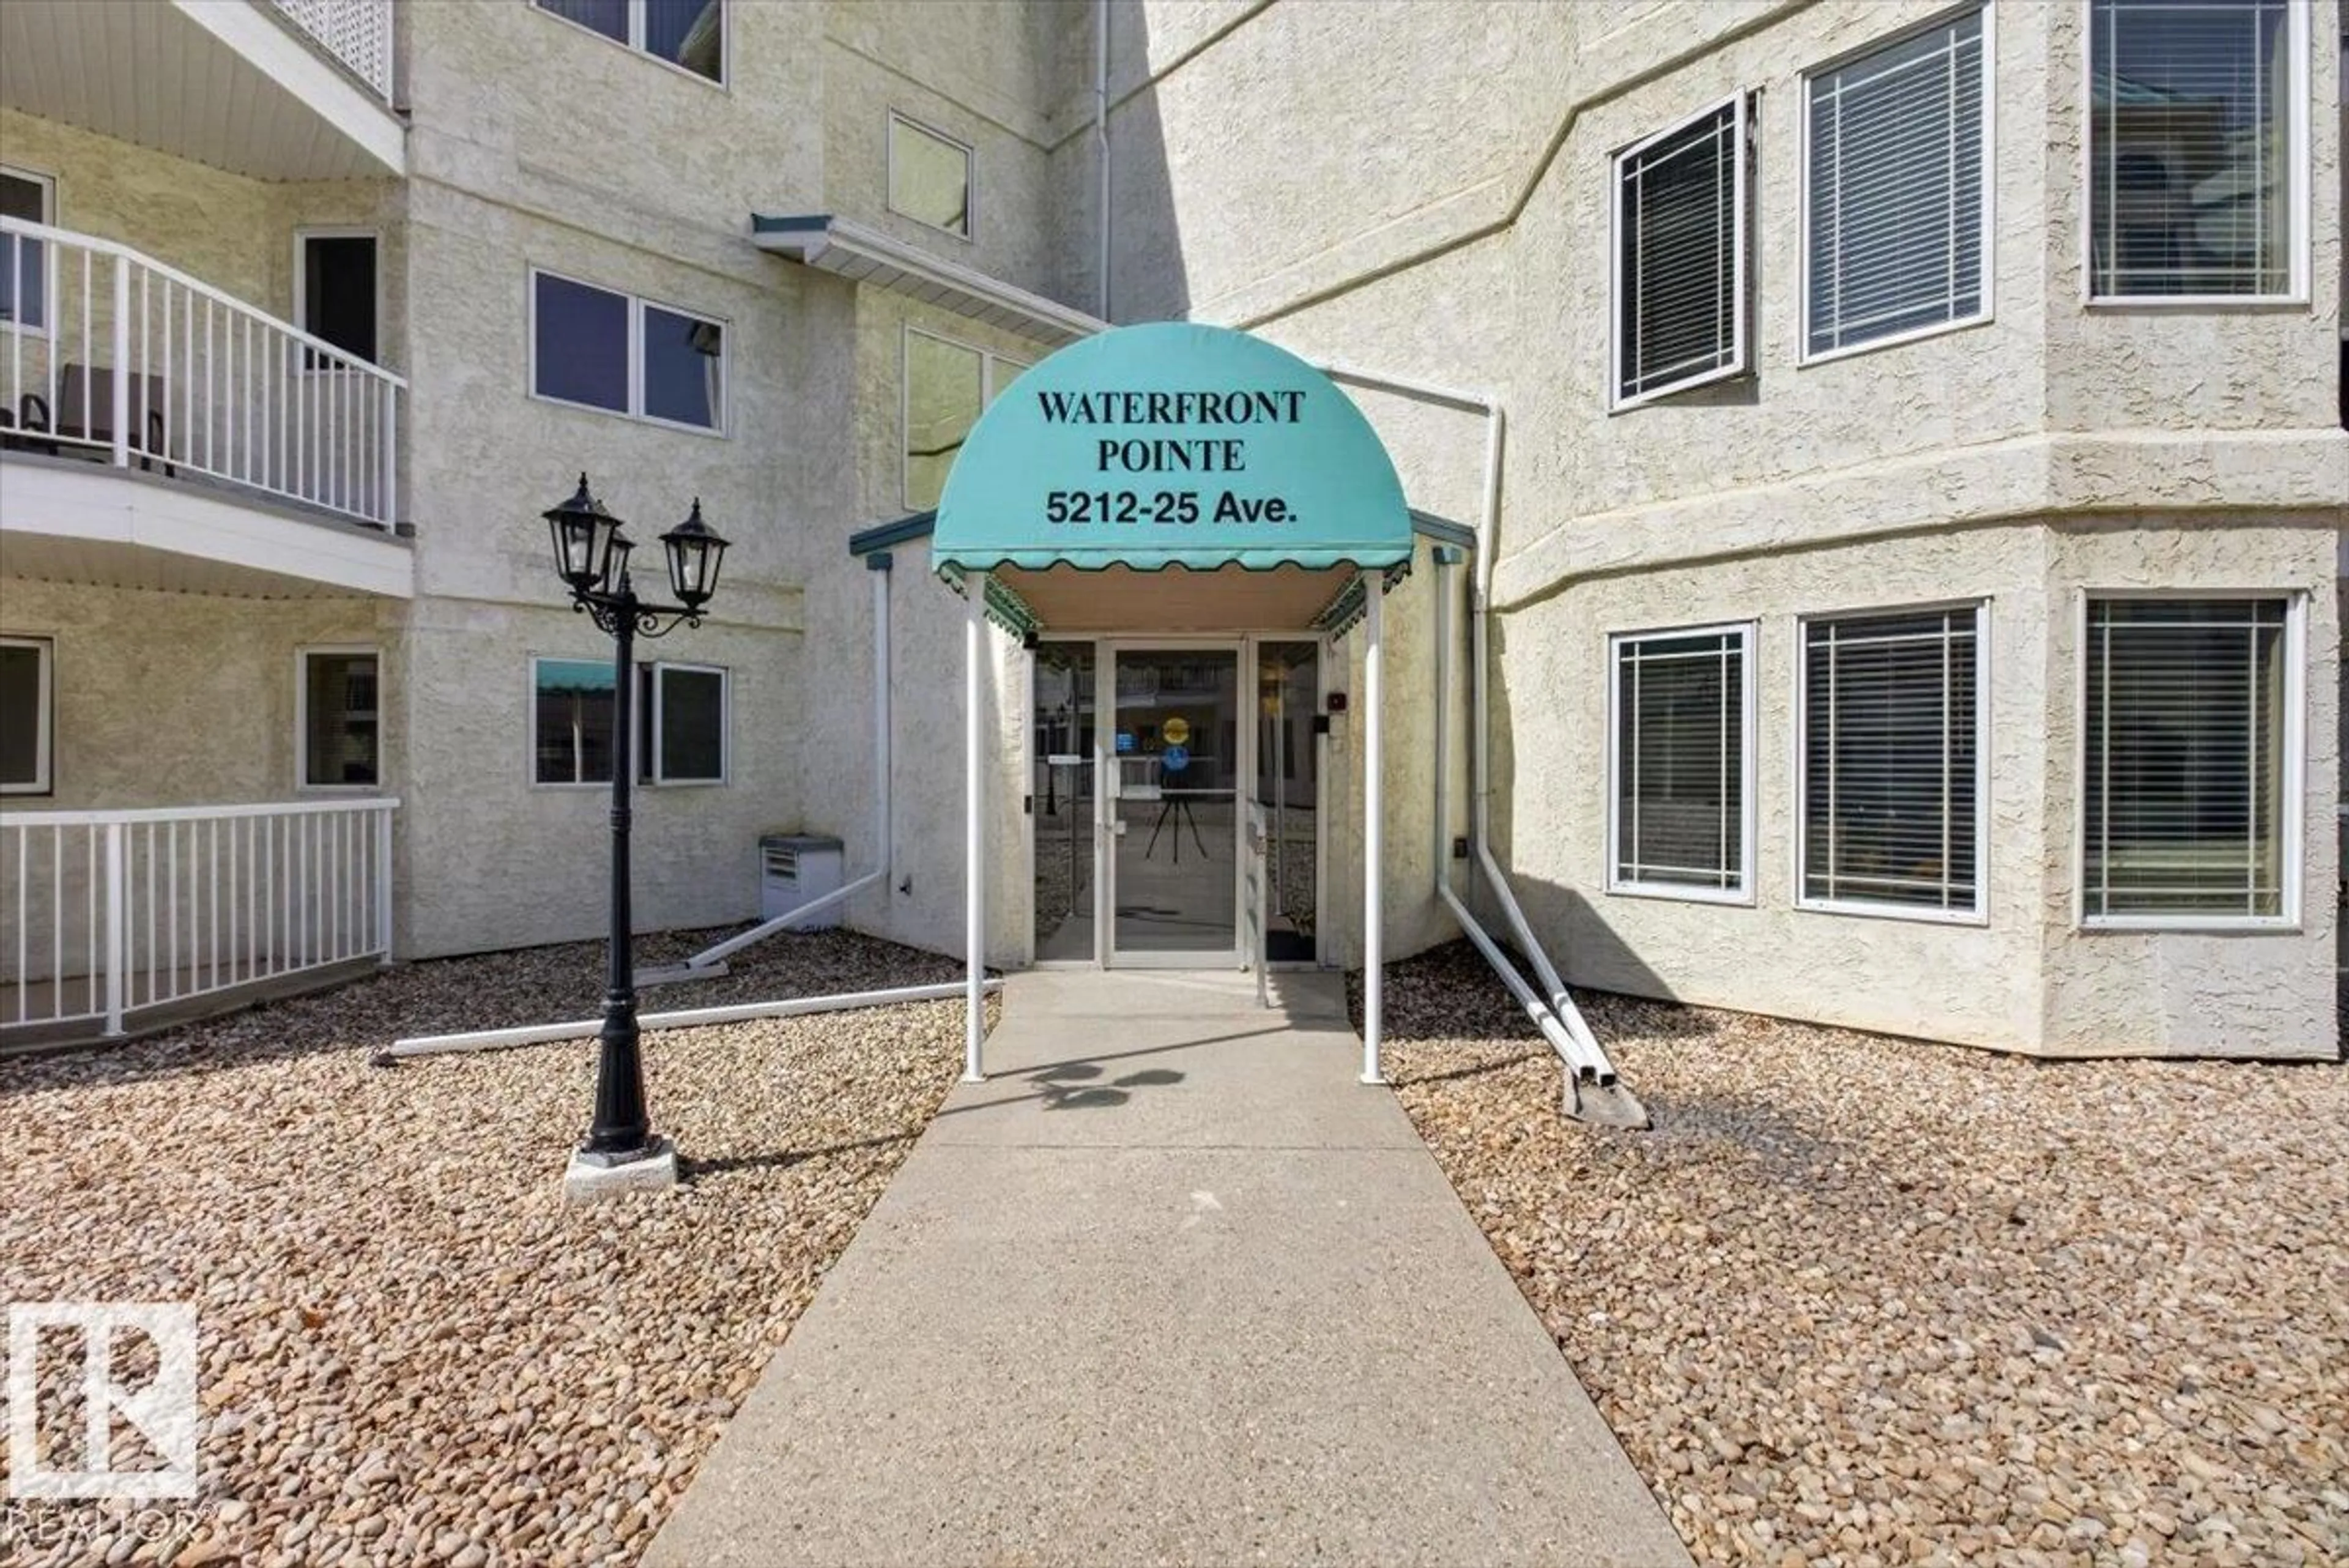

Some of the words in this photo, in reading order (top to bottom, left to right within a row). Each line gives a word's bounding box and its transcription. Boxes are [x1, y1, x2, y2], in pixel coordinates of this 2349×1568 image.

[1037, 390, 1307, 424] WATERFRONT
[1098, 439, 1246, 472] POINTE
[1046, 491, 1200, 524] 5212-25
[1212, 490, 1298, 524] Ave.
